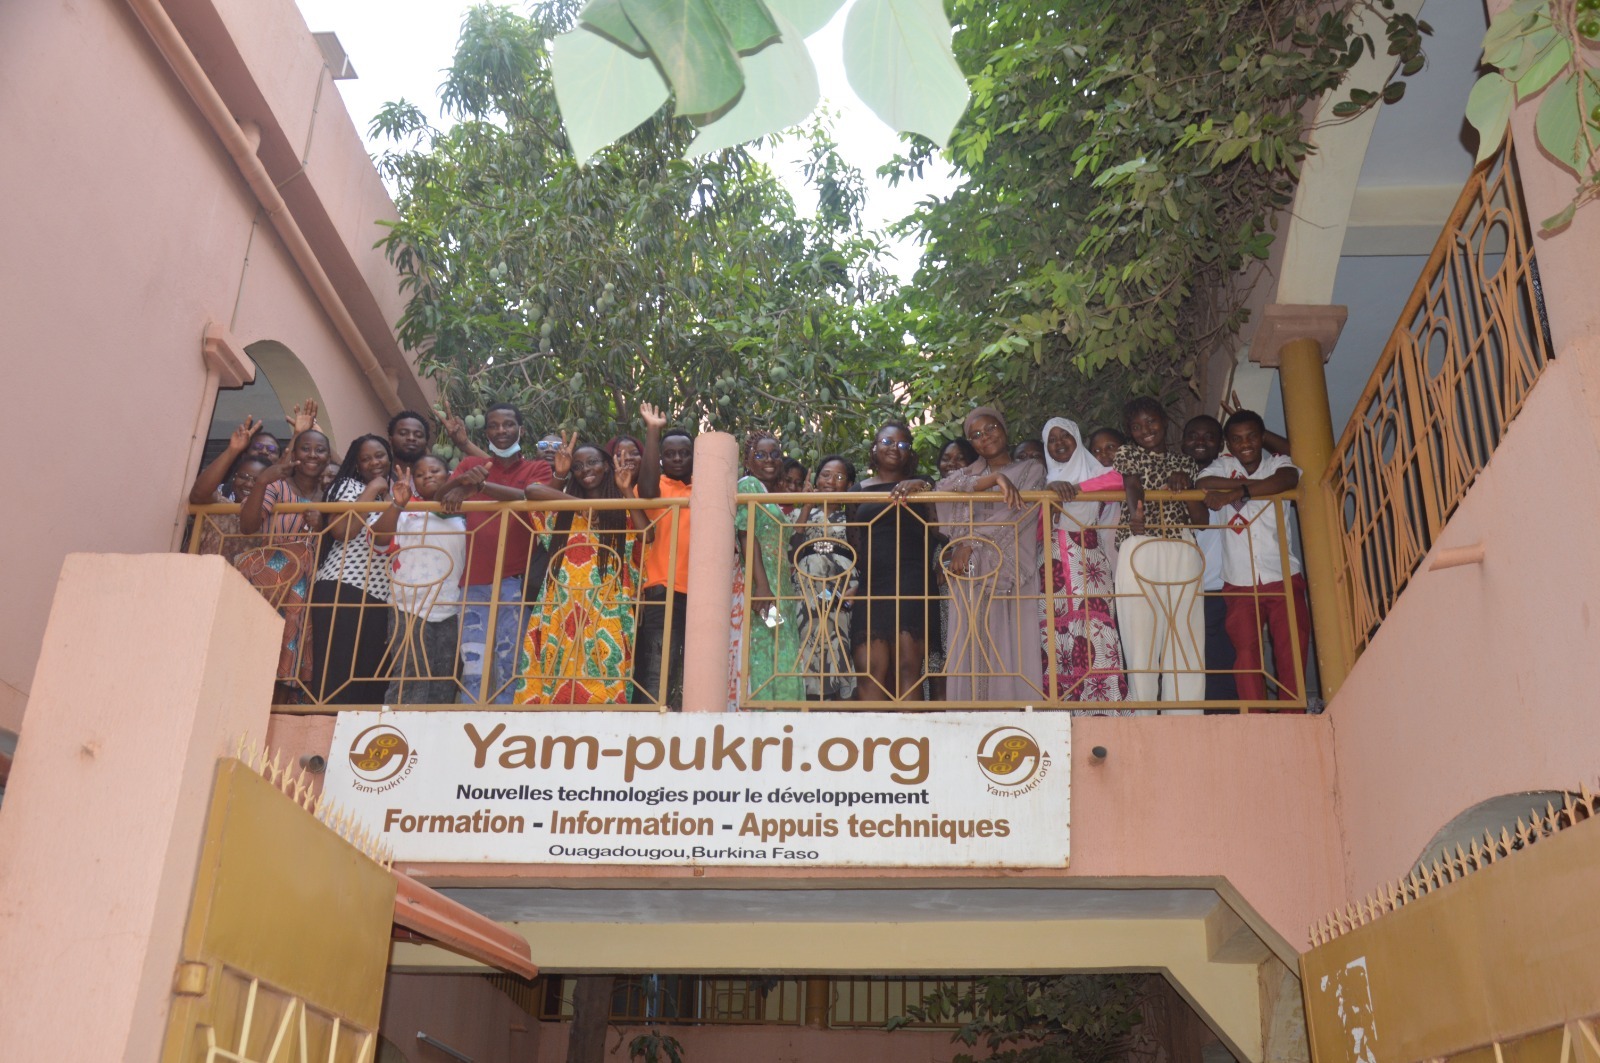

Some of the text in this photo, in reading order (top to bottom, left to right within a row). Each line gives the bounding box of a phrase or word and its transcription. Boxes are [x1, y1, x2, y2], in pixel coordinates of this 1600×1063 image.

[462, 722, 930, 786] Yam-pukri.org
[352, 757, 418, 795] Yam-pukri.org
[986, 760, 1052, 798] Yam-pukri.org
[456, 784, 930, 807] Nouvelles technologies pour le développement
[383, 808, 525, 834] Formation
[550, 810, 714, 836] Information
[738, 812, 839, 844] Appuis
[847, 813, 1011, 845] techniques
[772, 847, 820, 860] Faso
